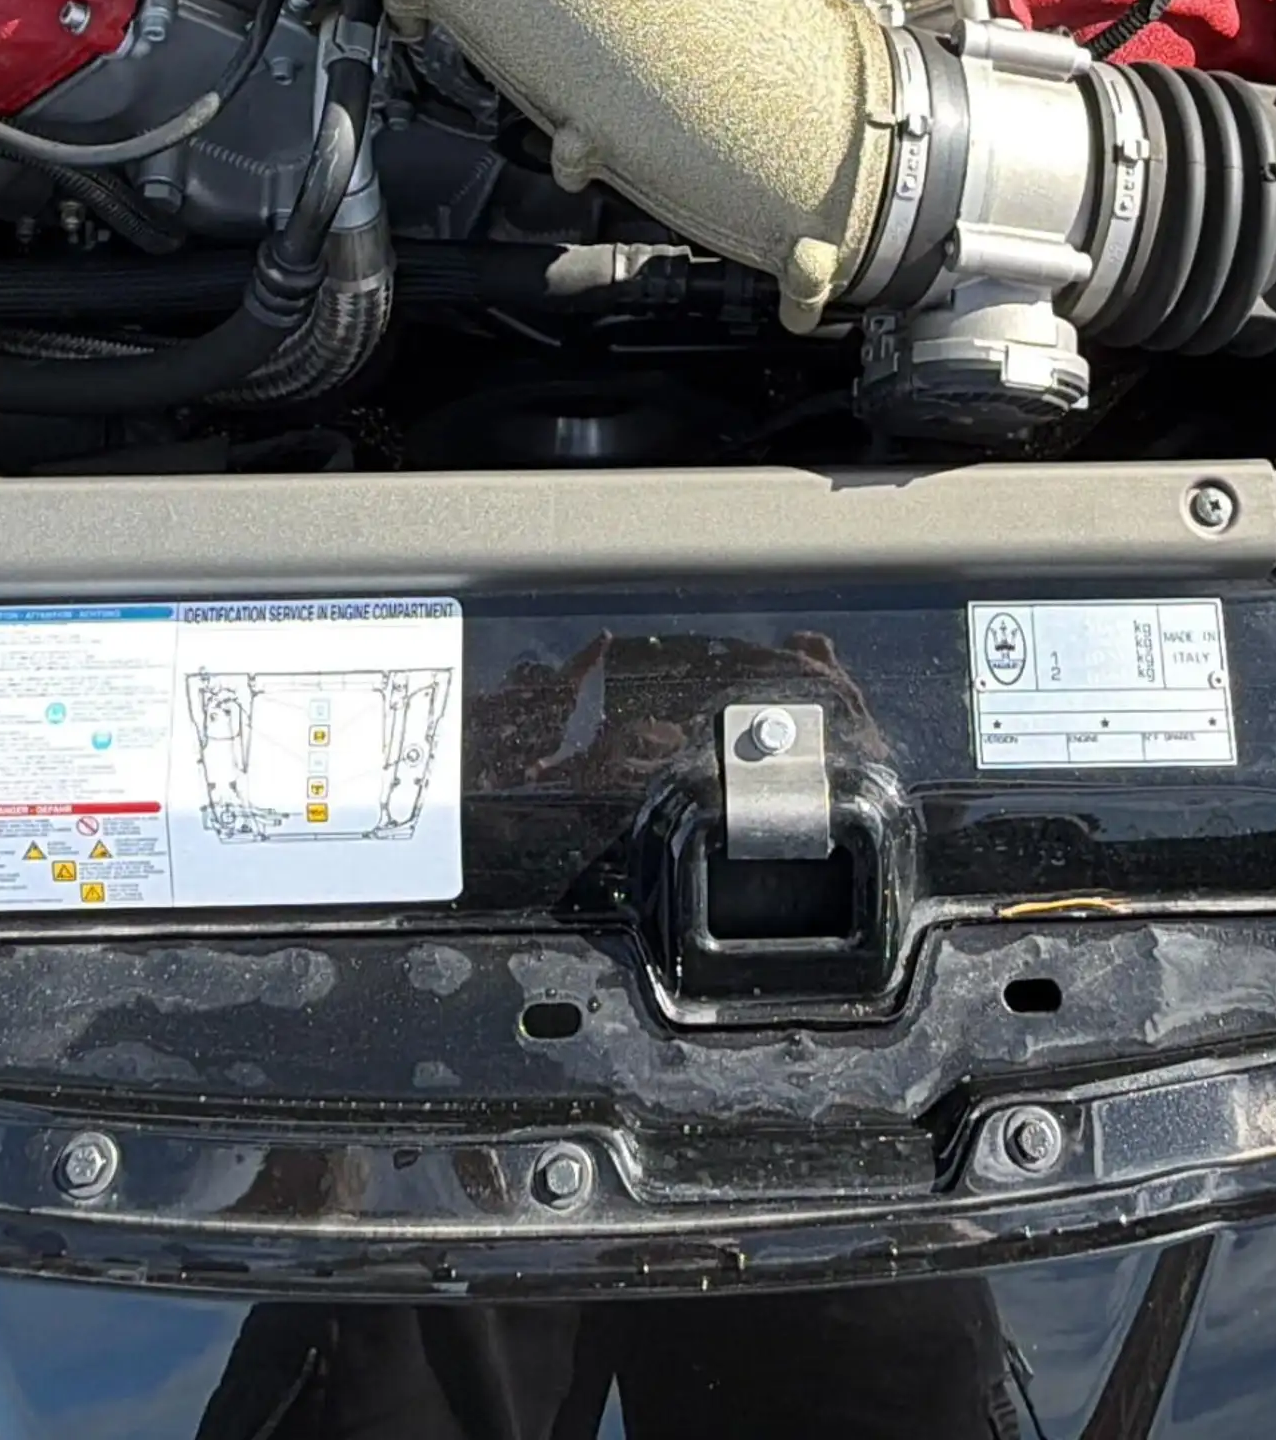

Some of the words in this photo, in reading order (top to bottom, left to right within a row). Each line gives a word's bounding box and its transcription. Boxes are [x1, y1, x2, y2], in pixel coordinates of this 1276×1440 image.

[183, 605, 267, 623] IDENTIFICATION
[268, 605, 314, 621] SERVICE
[316, 604, 329, 620] IN
[330, 603, 370, 620] ENGINE
[373, 602, 454, 619] COMPARTMENT
[1133, 620, 1152, 638] kg
[1163, 630, 1193, 643] MADE
[1202, 630, 1216, 642] IN
[1135, 635, 1153, 651] kg
[1050, 651, 1059, 667] 1
[1136, 649, 1154, 667] kg
[1173, 651, 1210, 664] ITALY
[1050, 666, 1061, 681] 2
[1138, 664, 1155, 682] kg
